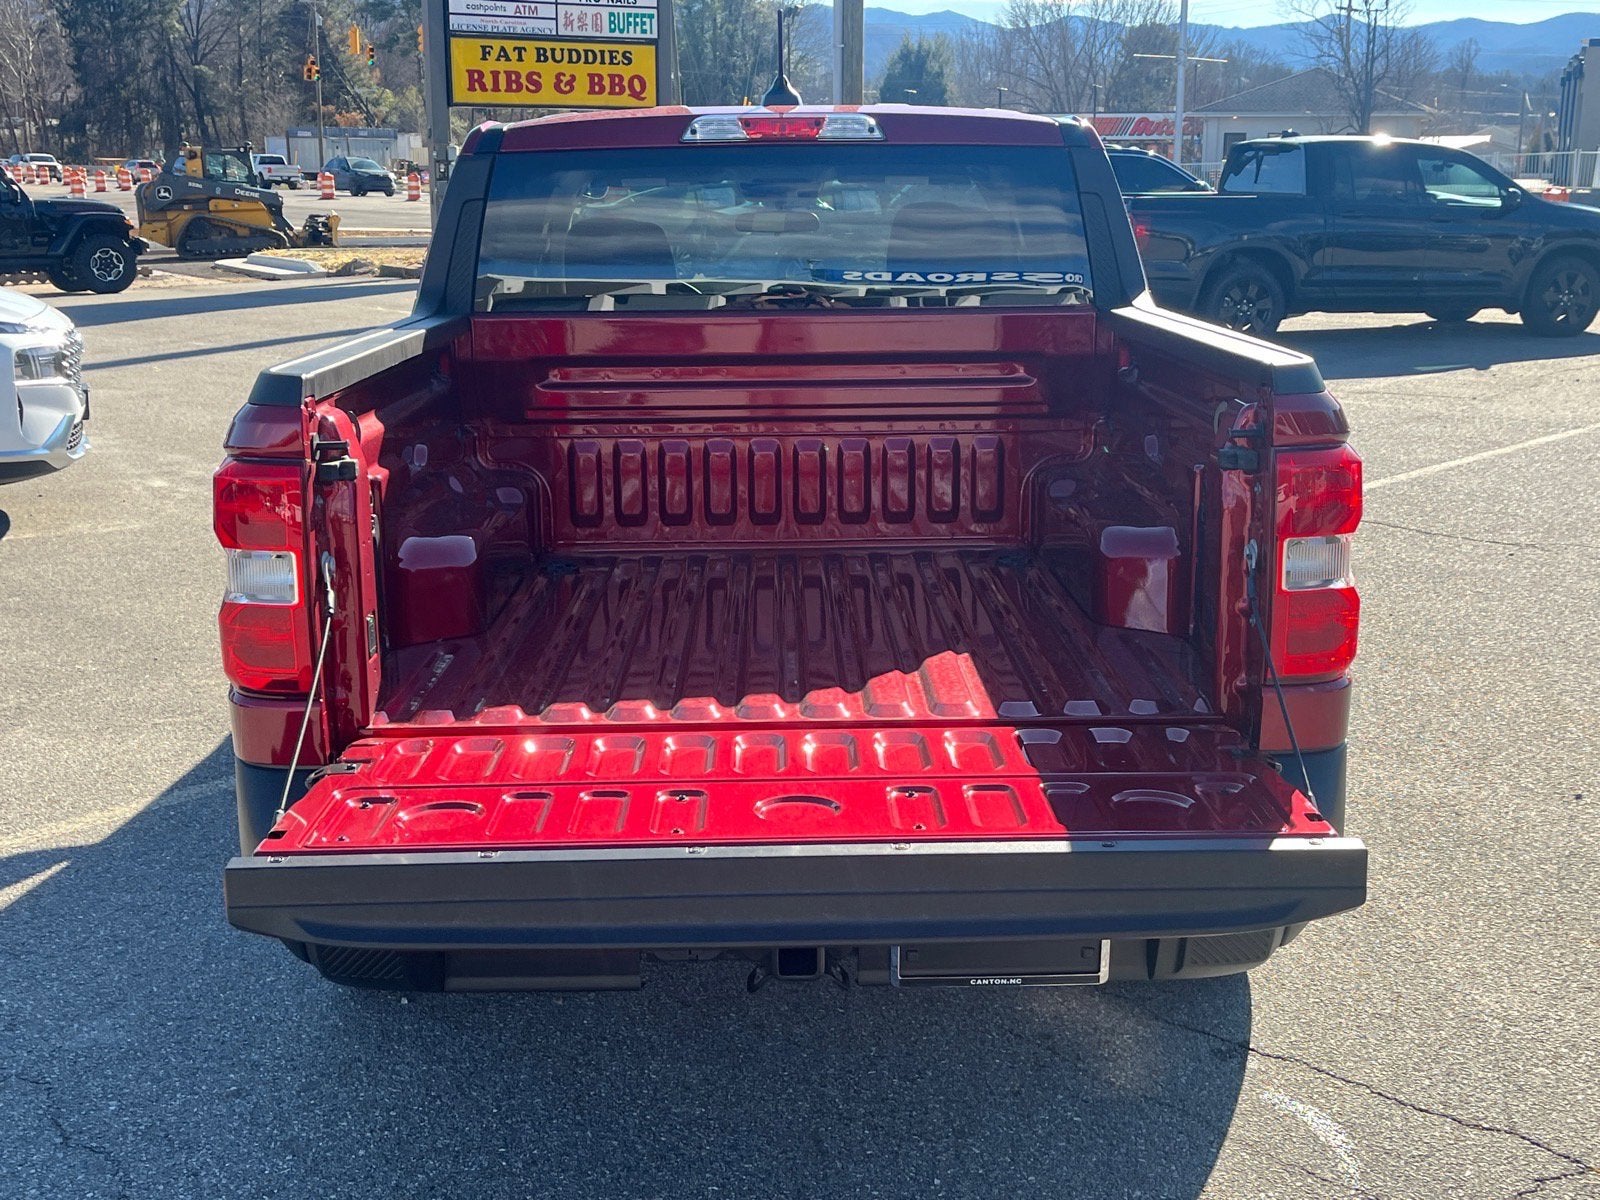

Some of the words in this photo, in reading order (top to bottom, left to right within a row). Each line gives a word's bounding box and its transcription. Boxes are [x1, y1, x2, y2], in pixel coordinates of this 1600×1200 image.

[466, 3, 507, 13] cashpoints
[513, 4, 538, 15] ATM
[452, 23, 489, 31] LICENSE
[491, 25, 518, 33] PLATE
[520, 26, 554, 34] AGENCY
[608, 12, 654, 34] BUFFET
[480, 45, 527, 62] FAT
[535, 46, 633, 65] BUDDIES
[466, 69, 543, 94] RIBS
[553, 72, 576, 95] &
[587, 72, 648, 100] BBQ
[234, 188, 260, 198] DEERE
